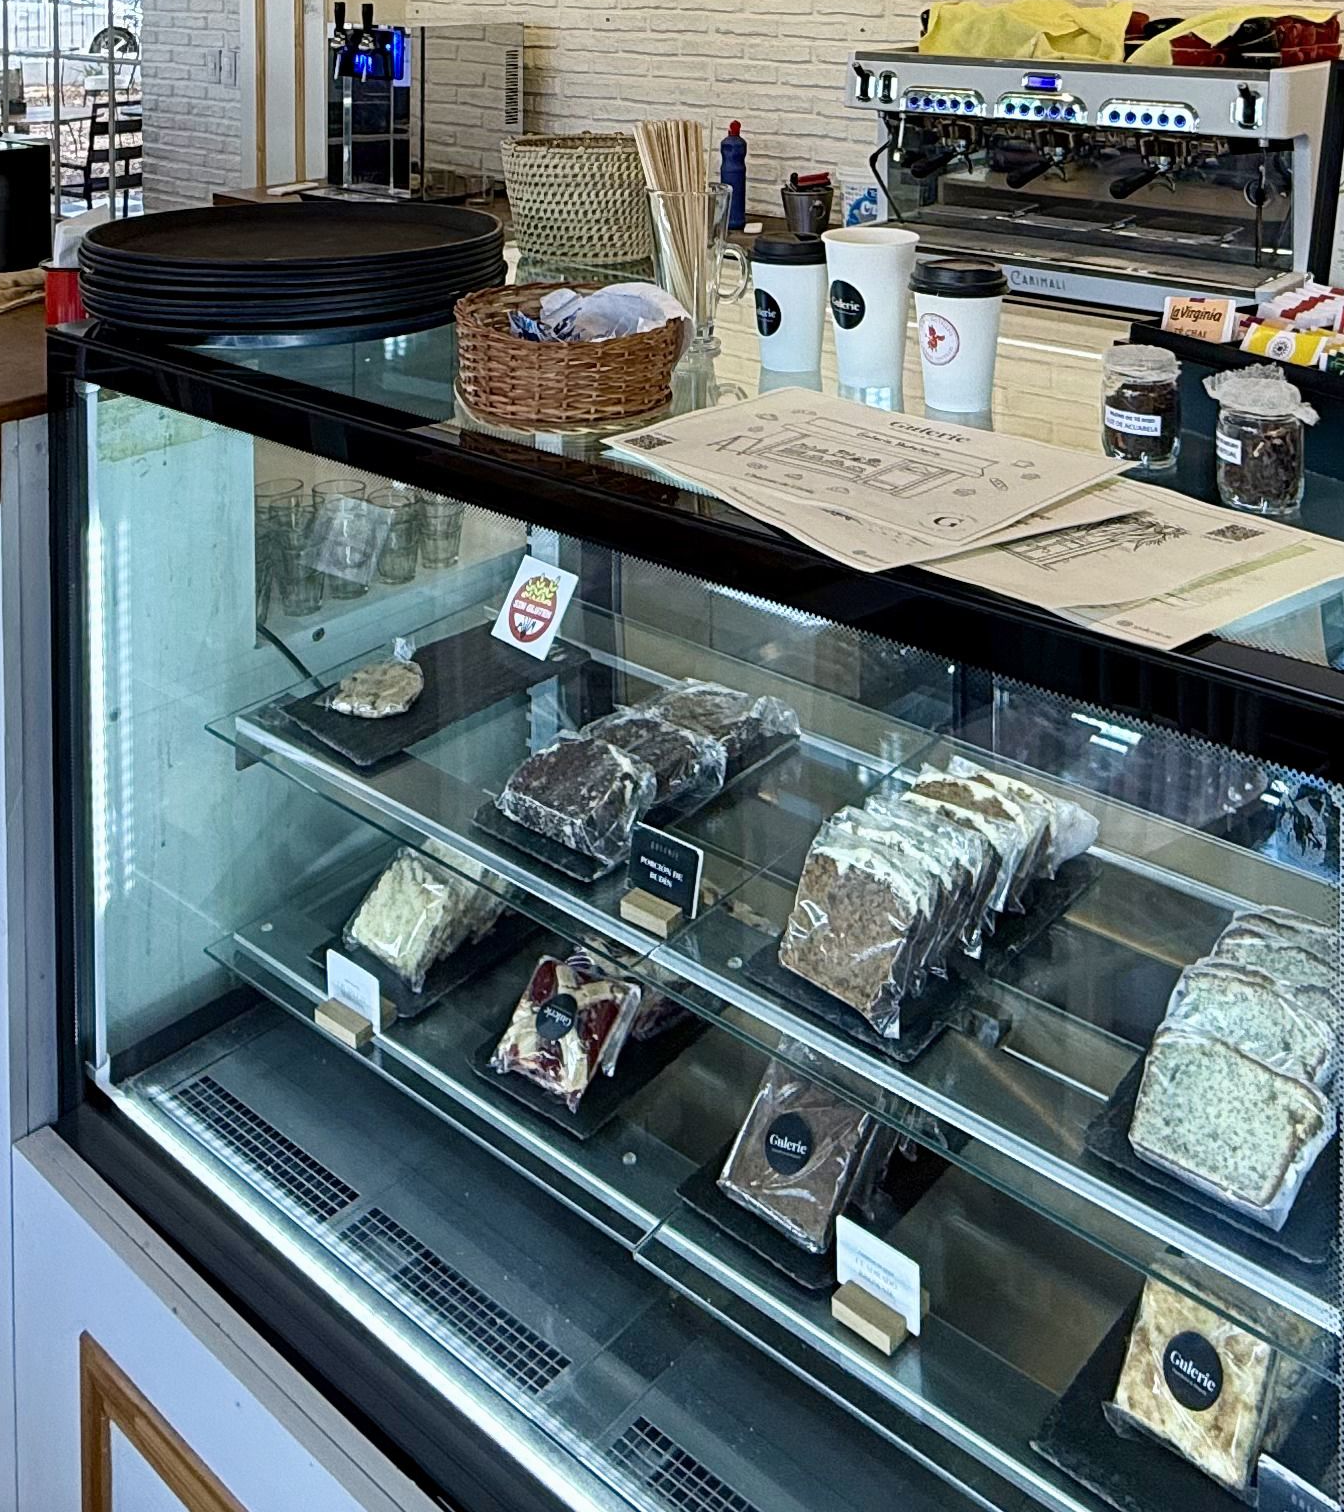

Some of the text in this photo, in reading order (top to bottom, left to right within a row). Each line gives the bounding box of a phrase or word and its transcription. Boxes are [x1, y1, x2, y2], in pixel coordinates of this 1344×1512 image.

[889, 421, 972, 443] Gulerie
[769, 1133, 807, 1155] Gulerie
[1170, 1350, 1216, 1392] Gulerie
